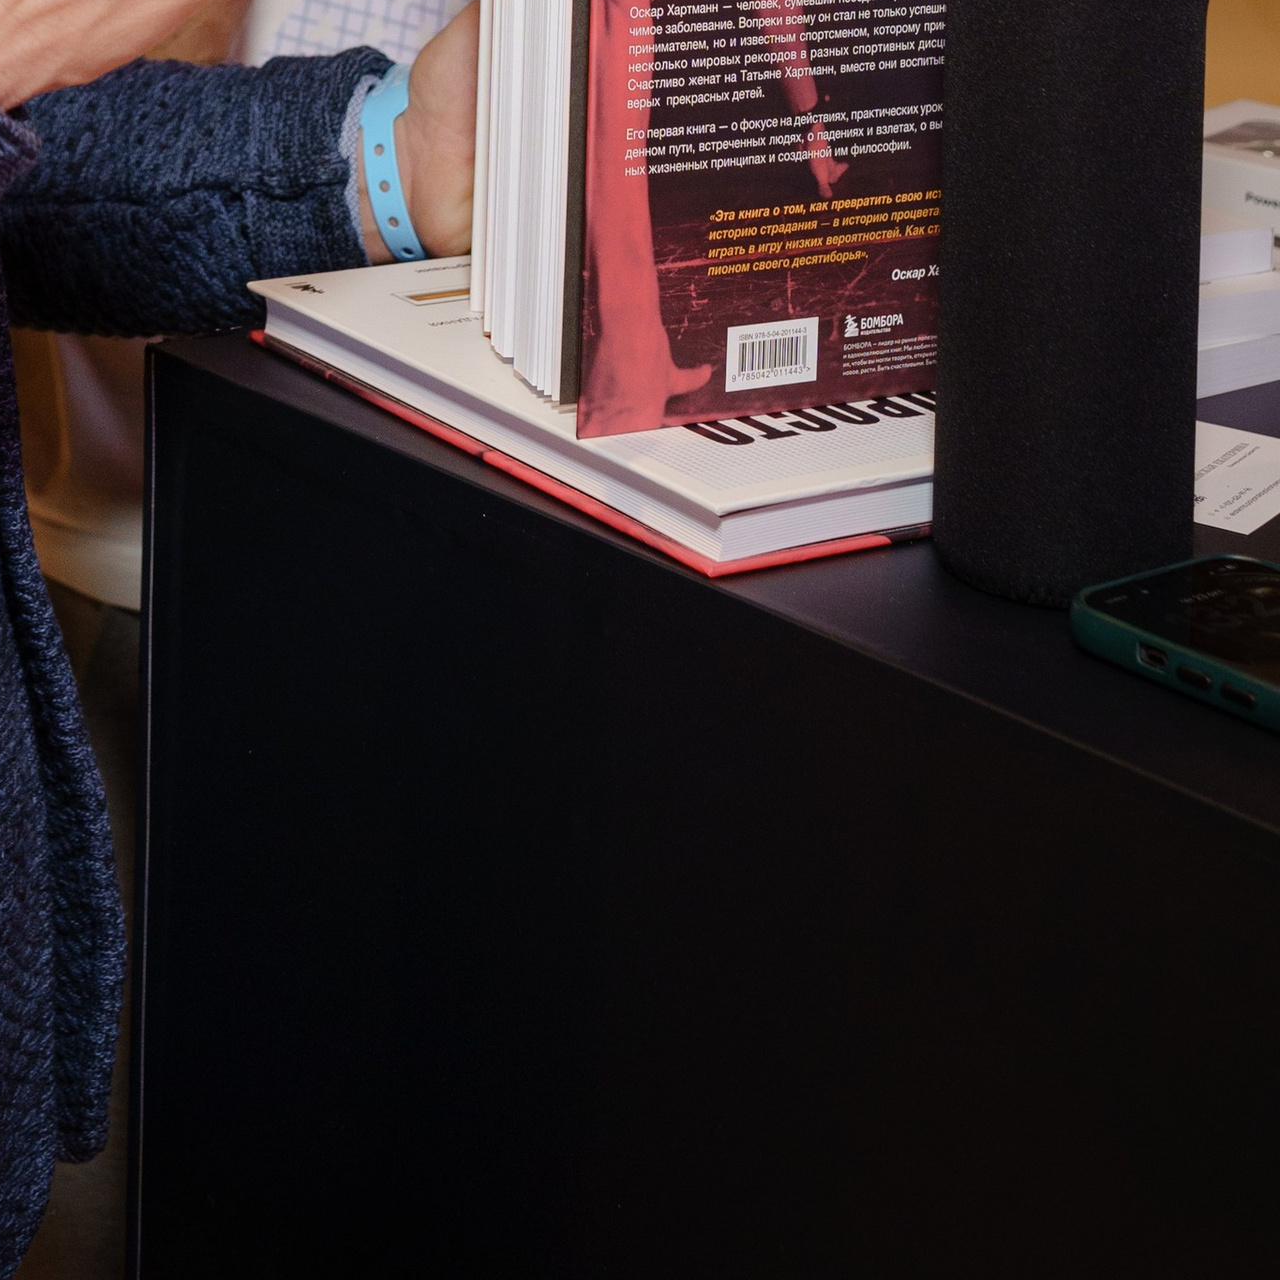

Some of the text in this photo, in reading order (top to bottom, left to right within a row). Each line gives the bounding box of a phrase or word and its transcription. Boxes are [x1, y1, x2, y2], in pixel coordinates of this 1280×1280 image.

[629, 6, 664, 19] Оскар
[666, 3, 718, 17] Хартманн
[736, 0, 780, 10] человек,
[629, 25, 662, 35] чимое
[664, 20, 735, 34] заболевание.
[738, 16, 782, 30] Вопреки
[785, 14, 816, 26] всему
[817, 12, 830, 22] он
[833, 10, 856, 21] стал
[858, 9, 870, 19] не
[872, 6, 907, 18] только
[629, 40, 709, 56] принимателем,
[713, 38, 726, 48] но
[729, 37, 736, 47] и
[740, 33, 795, 46] известным
[799, 27, 869, 43] спортсменом,
[873, 23, 921, 36] которому
[628, 59, 688, 72] несколько
[691, 55, 740, 69] мировых
[744, 50, 796, 66] рекордов
[800, 50, 806, 59] в
[810, 46, 849, 61] разных
[852, 41, 915, 56] спортивных
[627, 77, 685, 90] Счастливо
[688, 74, 721, 86] женат
[724, 73, 737, 83] на
[740, 69, 781, 81] Татьяне
[784, 65, 836, 79] Хартманн,
[840, 61, 875, 73] вместе
[878, 59, 896, 70] они
[627, 86, 764, 110] верых прекрасных детей.
[626, 103, 942, 140] Его первая книга о фокусе на действиях, практических урок
[625, 146, 665, 160] денном
[668, 143, 695, 156] пути,
[698, 136, 766, 153] встреченных
[768, 133, 804, 146] людях,
[807, 132, 814, 141] о
[817, 127, 864, 141] падениях
[866, 126, 873, 136] и
[876, 123, 917, 135] взлетах,
[920, 121, 927, 131] о
[625, 139, 911, 176] ных жизненных принципах и созданной им философии.
[709, 209, 735, 222] «Эта
[738, 207, 770, 219] книга
[772, 206, 780, 216] о
[783, 204, 806, 215] том,
[809, 201, 828, 212] как
[830, 195, 892, 211] превратить
[895, 191, 922, 203] свою
[708, 226, 757, 240] историю
[759, 220, 817, 236] страдания
[832, 218, 840, 227] в
[841, 212, 888, 226] историю
[708, 245, 745, 259] играть
[748, 244, 755, 254] в
[757, 241, 783, 254] игру
[785, 237, 823, 249] низких
[825, 226, 901, 246] вероятностей.
[904, 224, 925, 236] Как
[707, 250, 868, 276] пионом своего десятиборья».
[891, 268, 925, 281] Оскар
[739, 327, 807, 342] ISBN 978-5-04-201144-3
[860, 313, 904, 330] БОМБОРА
[731, 366, 803, 382] 9 785042 011443
